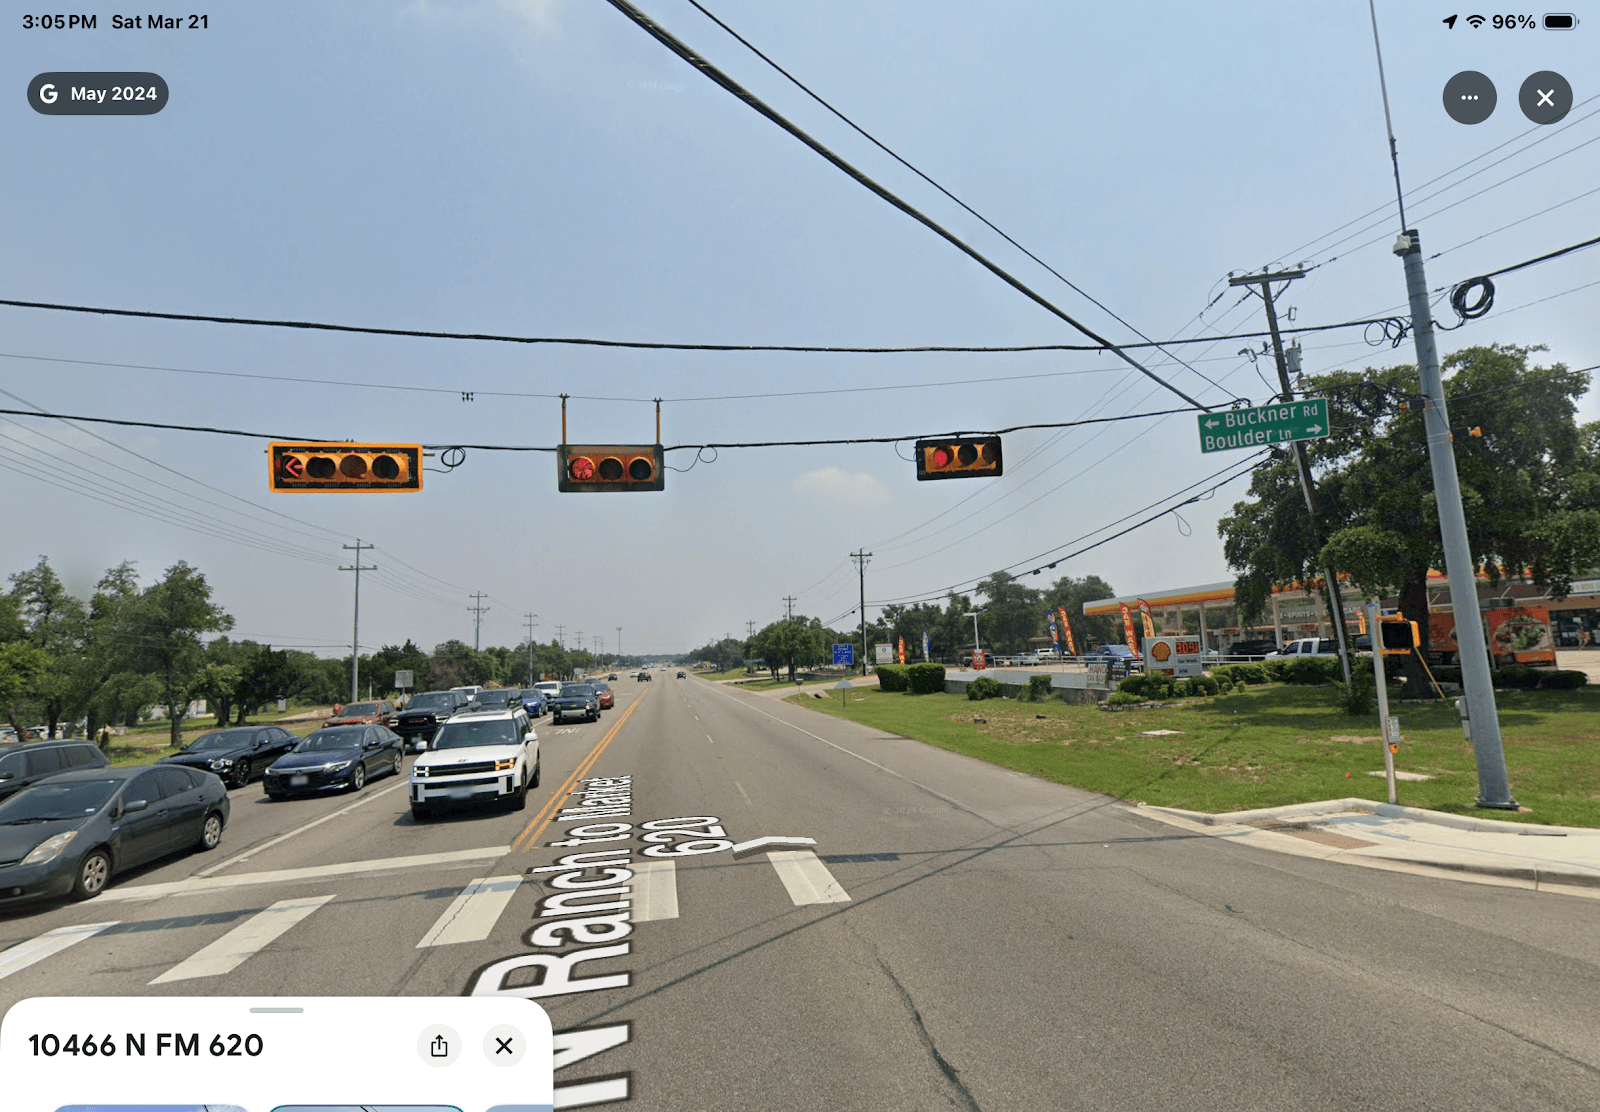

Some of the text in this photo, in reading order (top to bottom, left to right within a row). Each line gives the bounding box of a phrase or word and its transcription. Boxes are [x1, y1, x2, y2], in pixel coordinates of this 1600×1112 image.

[1225, 403, 1319, 428] Buckner Rd
[1205, 429, 1292, 450] Boulder Ln
